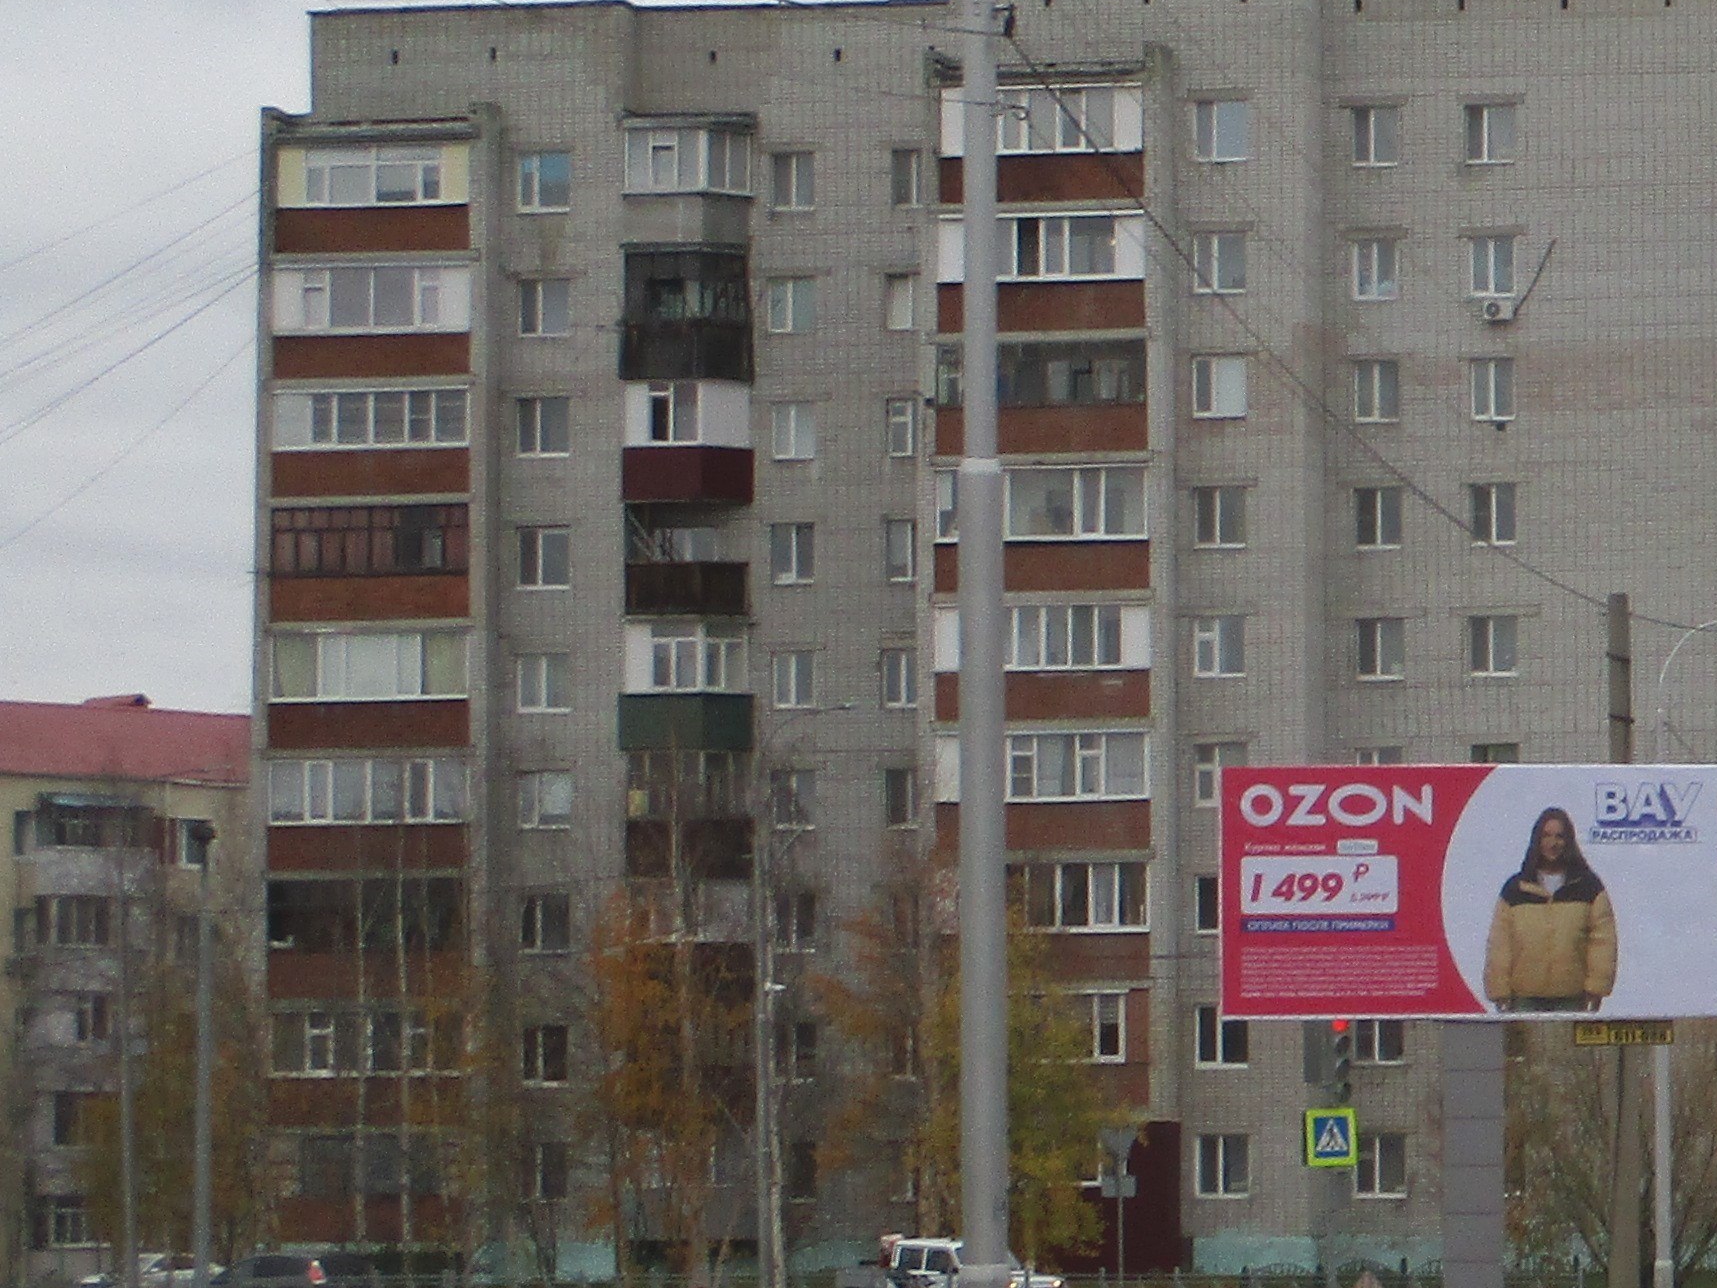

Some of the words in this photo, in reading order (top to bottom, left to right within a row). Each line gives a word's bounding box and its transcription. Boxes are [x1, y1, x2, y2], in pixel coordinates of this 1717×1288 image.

[1240, 783, 1434, 827] OZON
[1595, 781, 1703, 827] ВАУ
[1592, 828, 1694, 842] РАСПРОДАЖА
